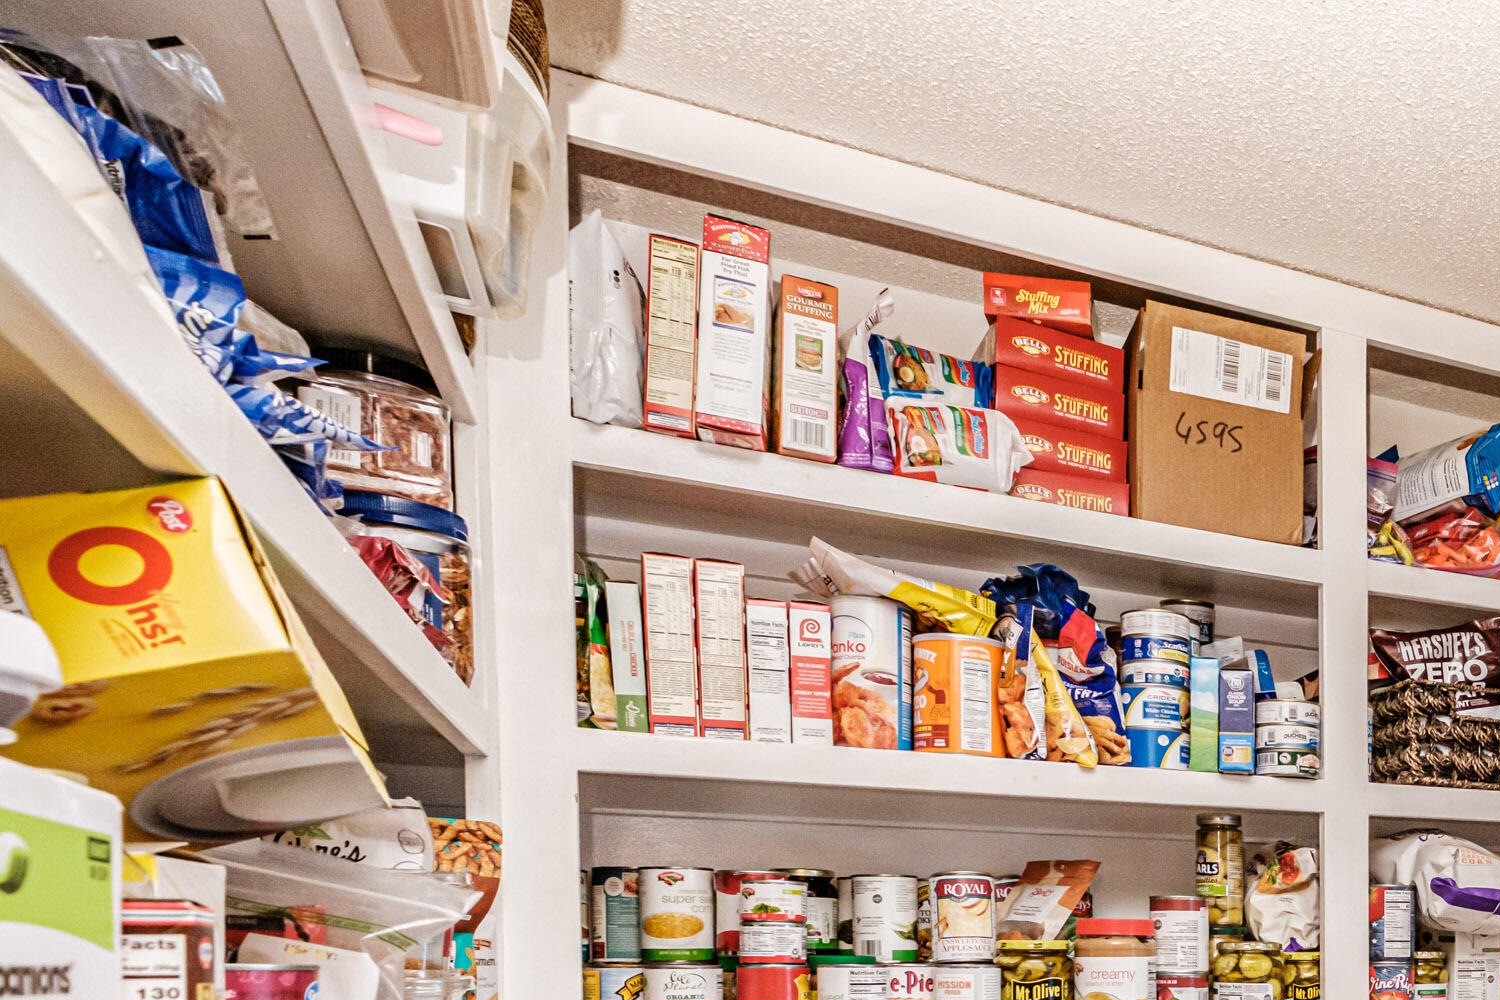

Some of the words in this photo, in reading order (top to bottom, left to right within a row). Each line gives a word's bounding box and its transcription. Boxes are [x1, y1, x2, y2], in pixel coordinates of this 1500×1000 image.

[786, 294, 833, 311] GOURMET
[1016, 289, 1060, 308] Stuffing
[785, 302, 833, 319] STUFFING
[1028, 303, 1048, 314] Mix
[1015, 338, 1049, 354] BELL'S
[1055, 346, 1108, 376] STUFFING
[1015, 387, 1047, 401] BELL'S
[1054, 394, 1108, 421] STUFFING
[1175, 412, 1243, 453] 4595
[1057, 442, 1111, 469] STUFFING
[1057, 489, 1112, 512] STUFFING
[151, 500, 187, 530] Post
[1399, 632, 1486, 661] HERSHEY'S
[1405, 659, 1488, 685] ZERO
[1147, 694, 1177, 702] CRIDER
[944, 882, 987, 897] ROYAL
[1091, 969, 1135, 982] creamy
[938, 981, 971, 989] MISSION
[1033, 984, 1062, 1000] Olive
[137, 988, 180, 1000] 130
